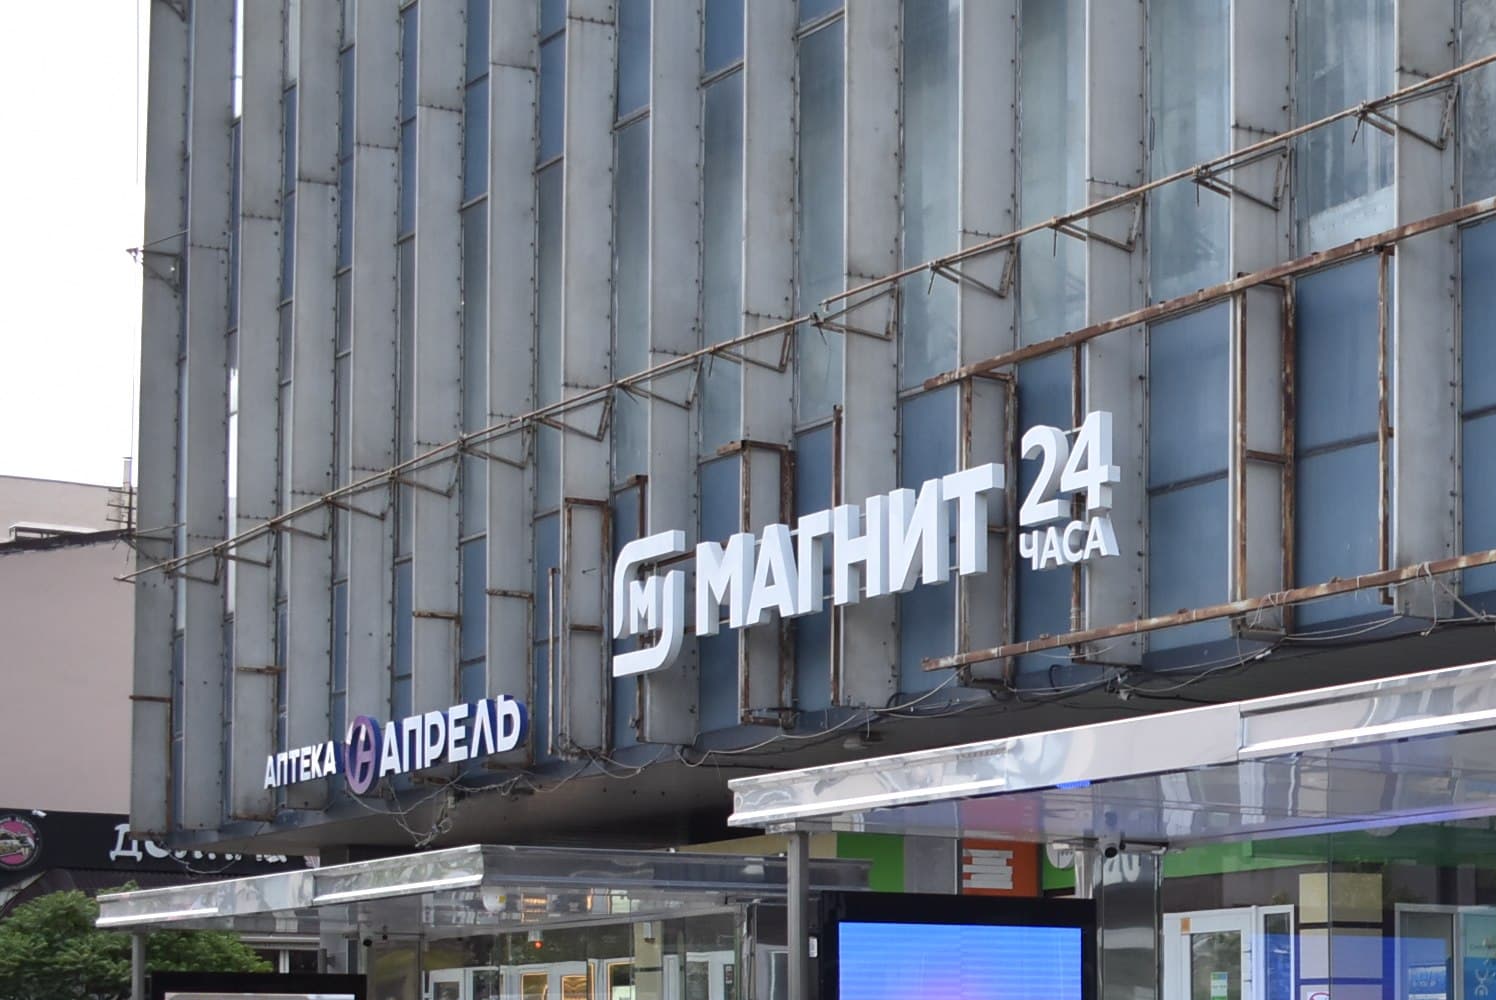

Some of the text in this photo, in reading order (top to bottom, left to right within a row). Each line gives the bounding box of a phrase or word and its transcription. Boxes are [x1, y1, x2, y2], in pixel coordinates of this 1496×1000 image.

[1019, 411, 1121, 527] 24
[696, 462, 1005, 637] МАГНИТ
[1019, 516, 1120, 570] ЧАСА
[264, 740, 338, 790] АПТЕКА
[379, 694, 527, 777] АПРЕЛЬ
